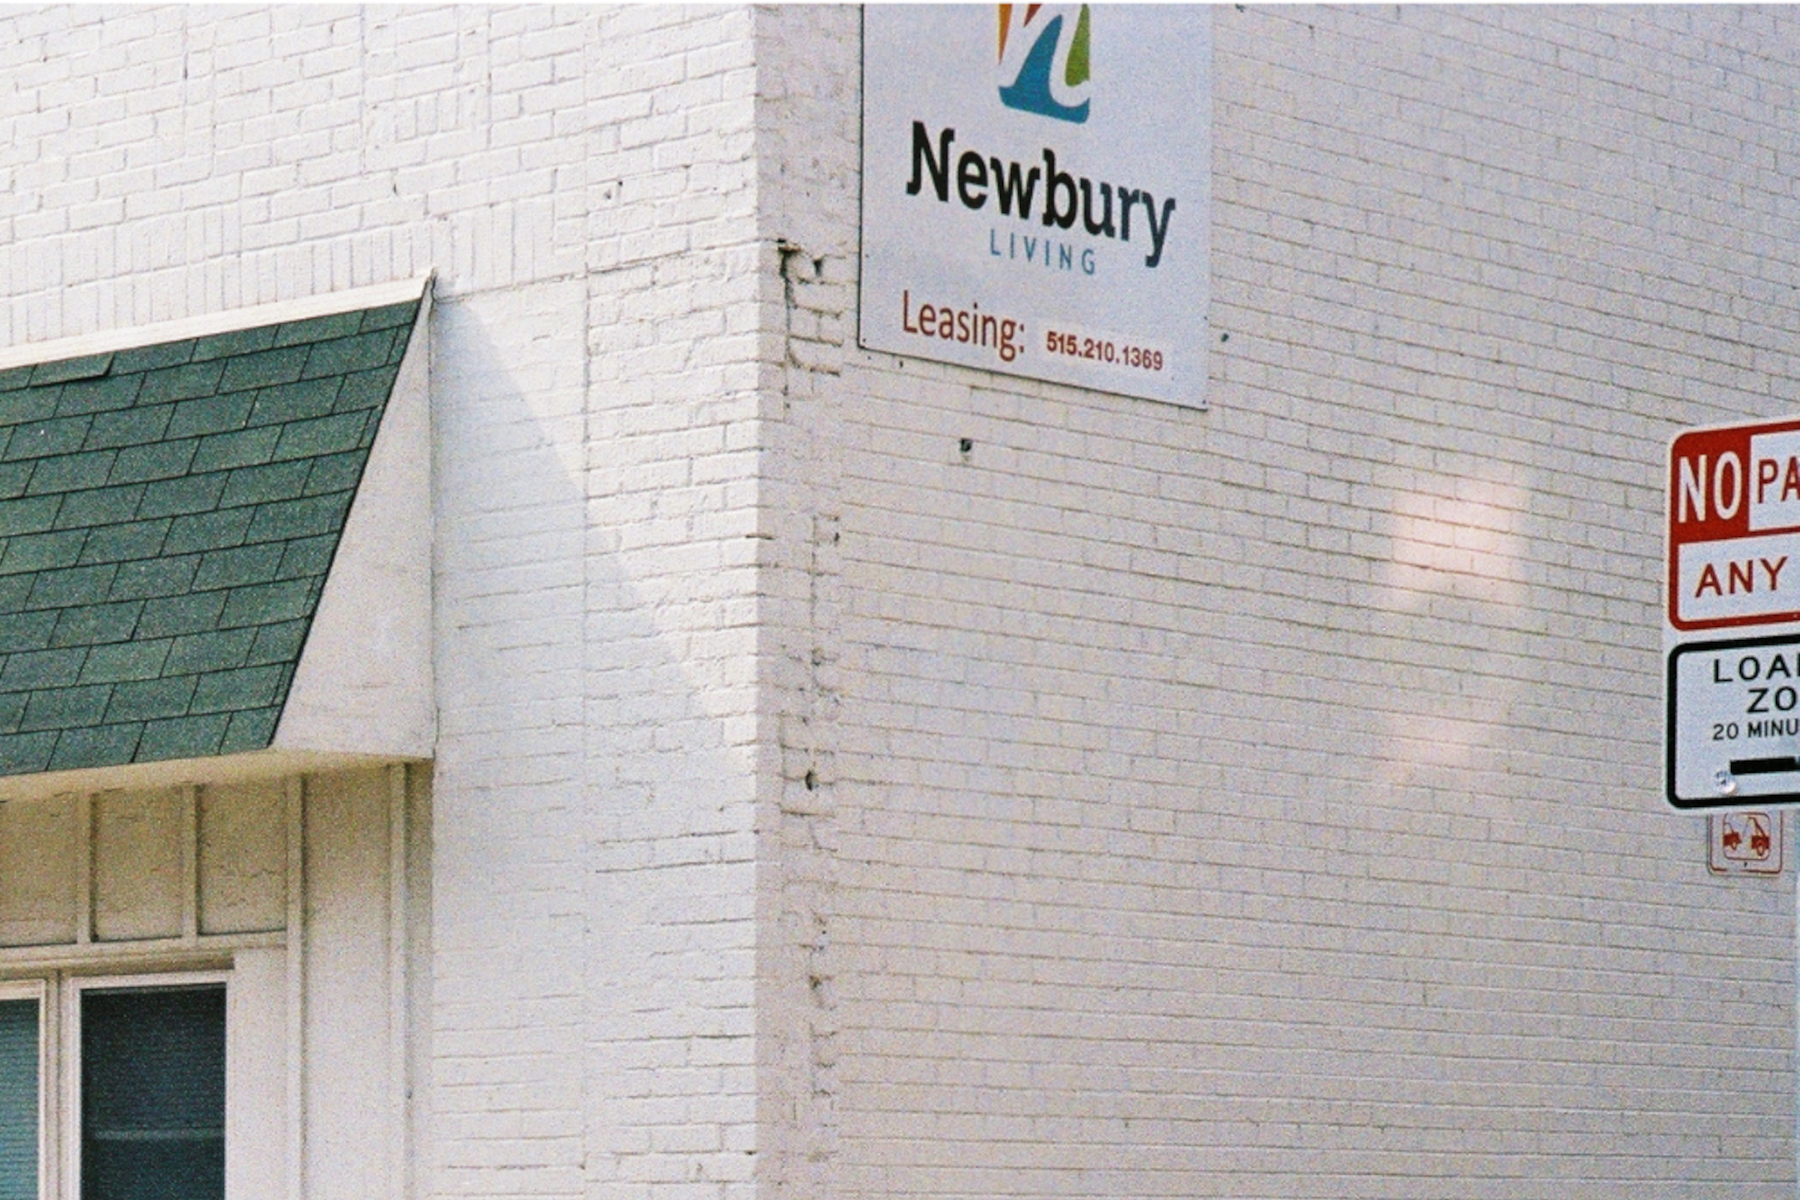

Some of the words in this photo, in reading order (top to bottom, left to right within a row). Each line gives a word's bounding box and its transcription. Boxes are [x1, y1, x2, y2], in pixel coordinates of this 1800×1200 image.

[906, 120, 1176, 268] Newbury
[990, 229, 1095, 275] LIVING
[902, 289, 1025, 362] Leasing:
[1046, 331, 1163, 371] 515.210.1369
[1678, 451, 1742, 523] NO
[1695, 556, 1788, 598] ANY
[1714, 652, 1800, 683] LOA
[1746, 686, 1798, 713] ZO
[1713, 722, 1739, 740] 20
[1747, 718, 1799, 738] MINU
